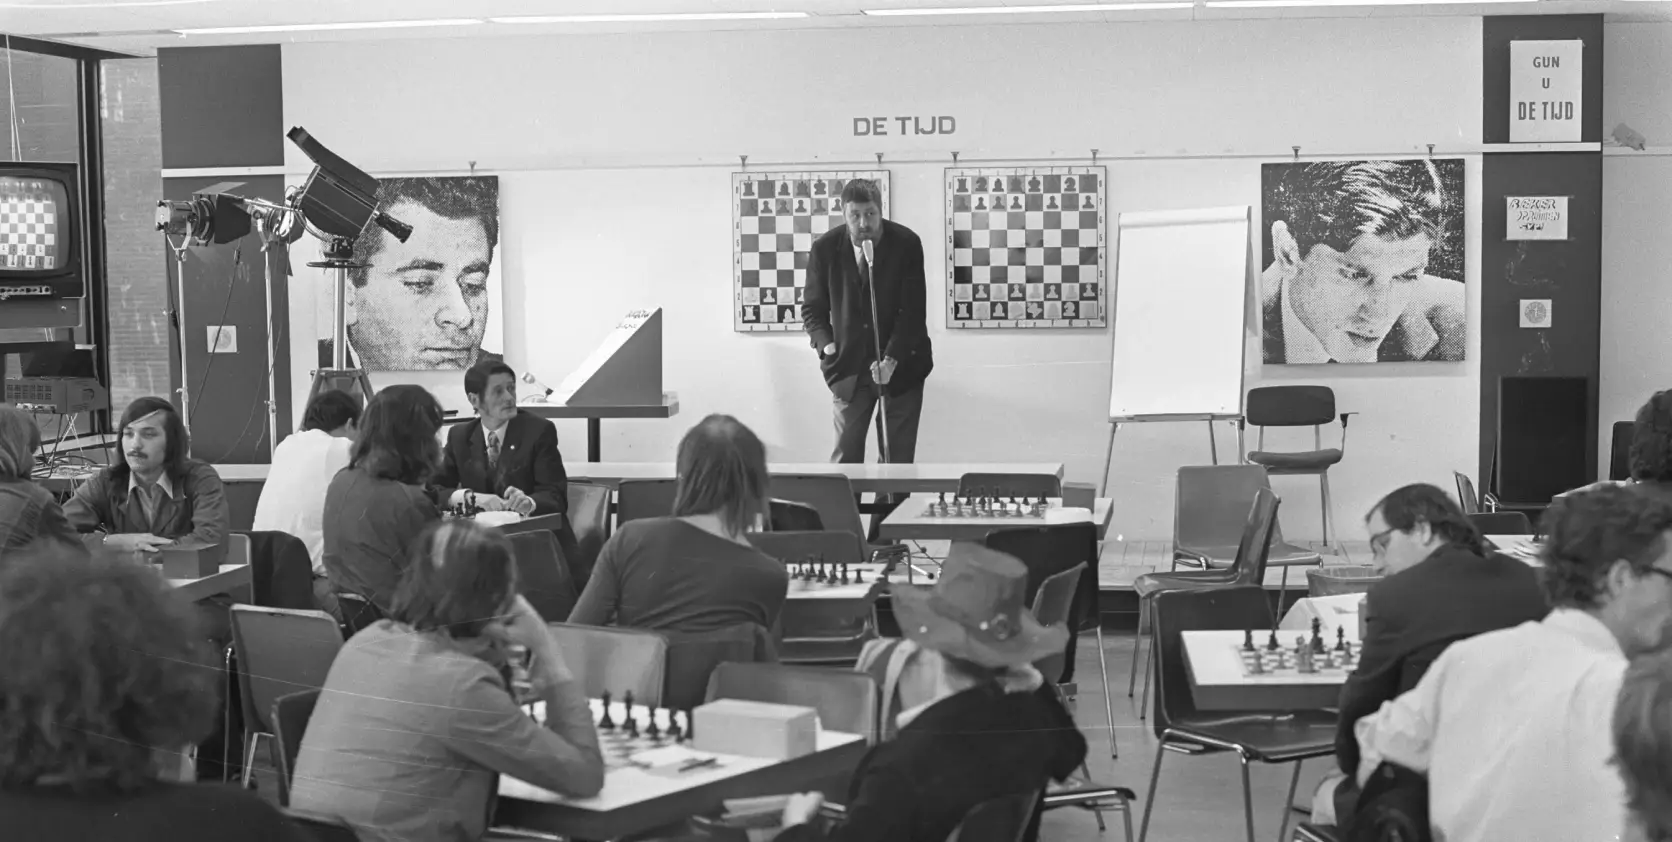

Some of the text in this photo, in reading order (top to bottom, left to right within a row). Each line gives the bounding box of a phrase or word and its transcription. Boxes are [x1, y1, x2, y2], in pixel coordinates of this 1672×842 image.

[1533, 56, 1560, 68] GUN
[1542, 77, 1550, 89] U
[1518, 101, 1574, 121] DE TIJD
[853, 116, 956, 136] DE TIJD
